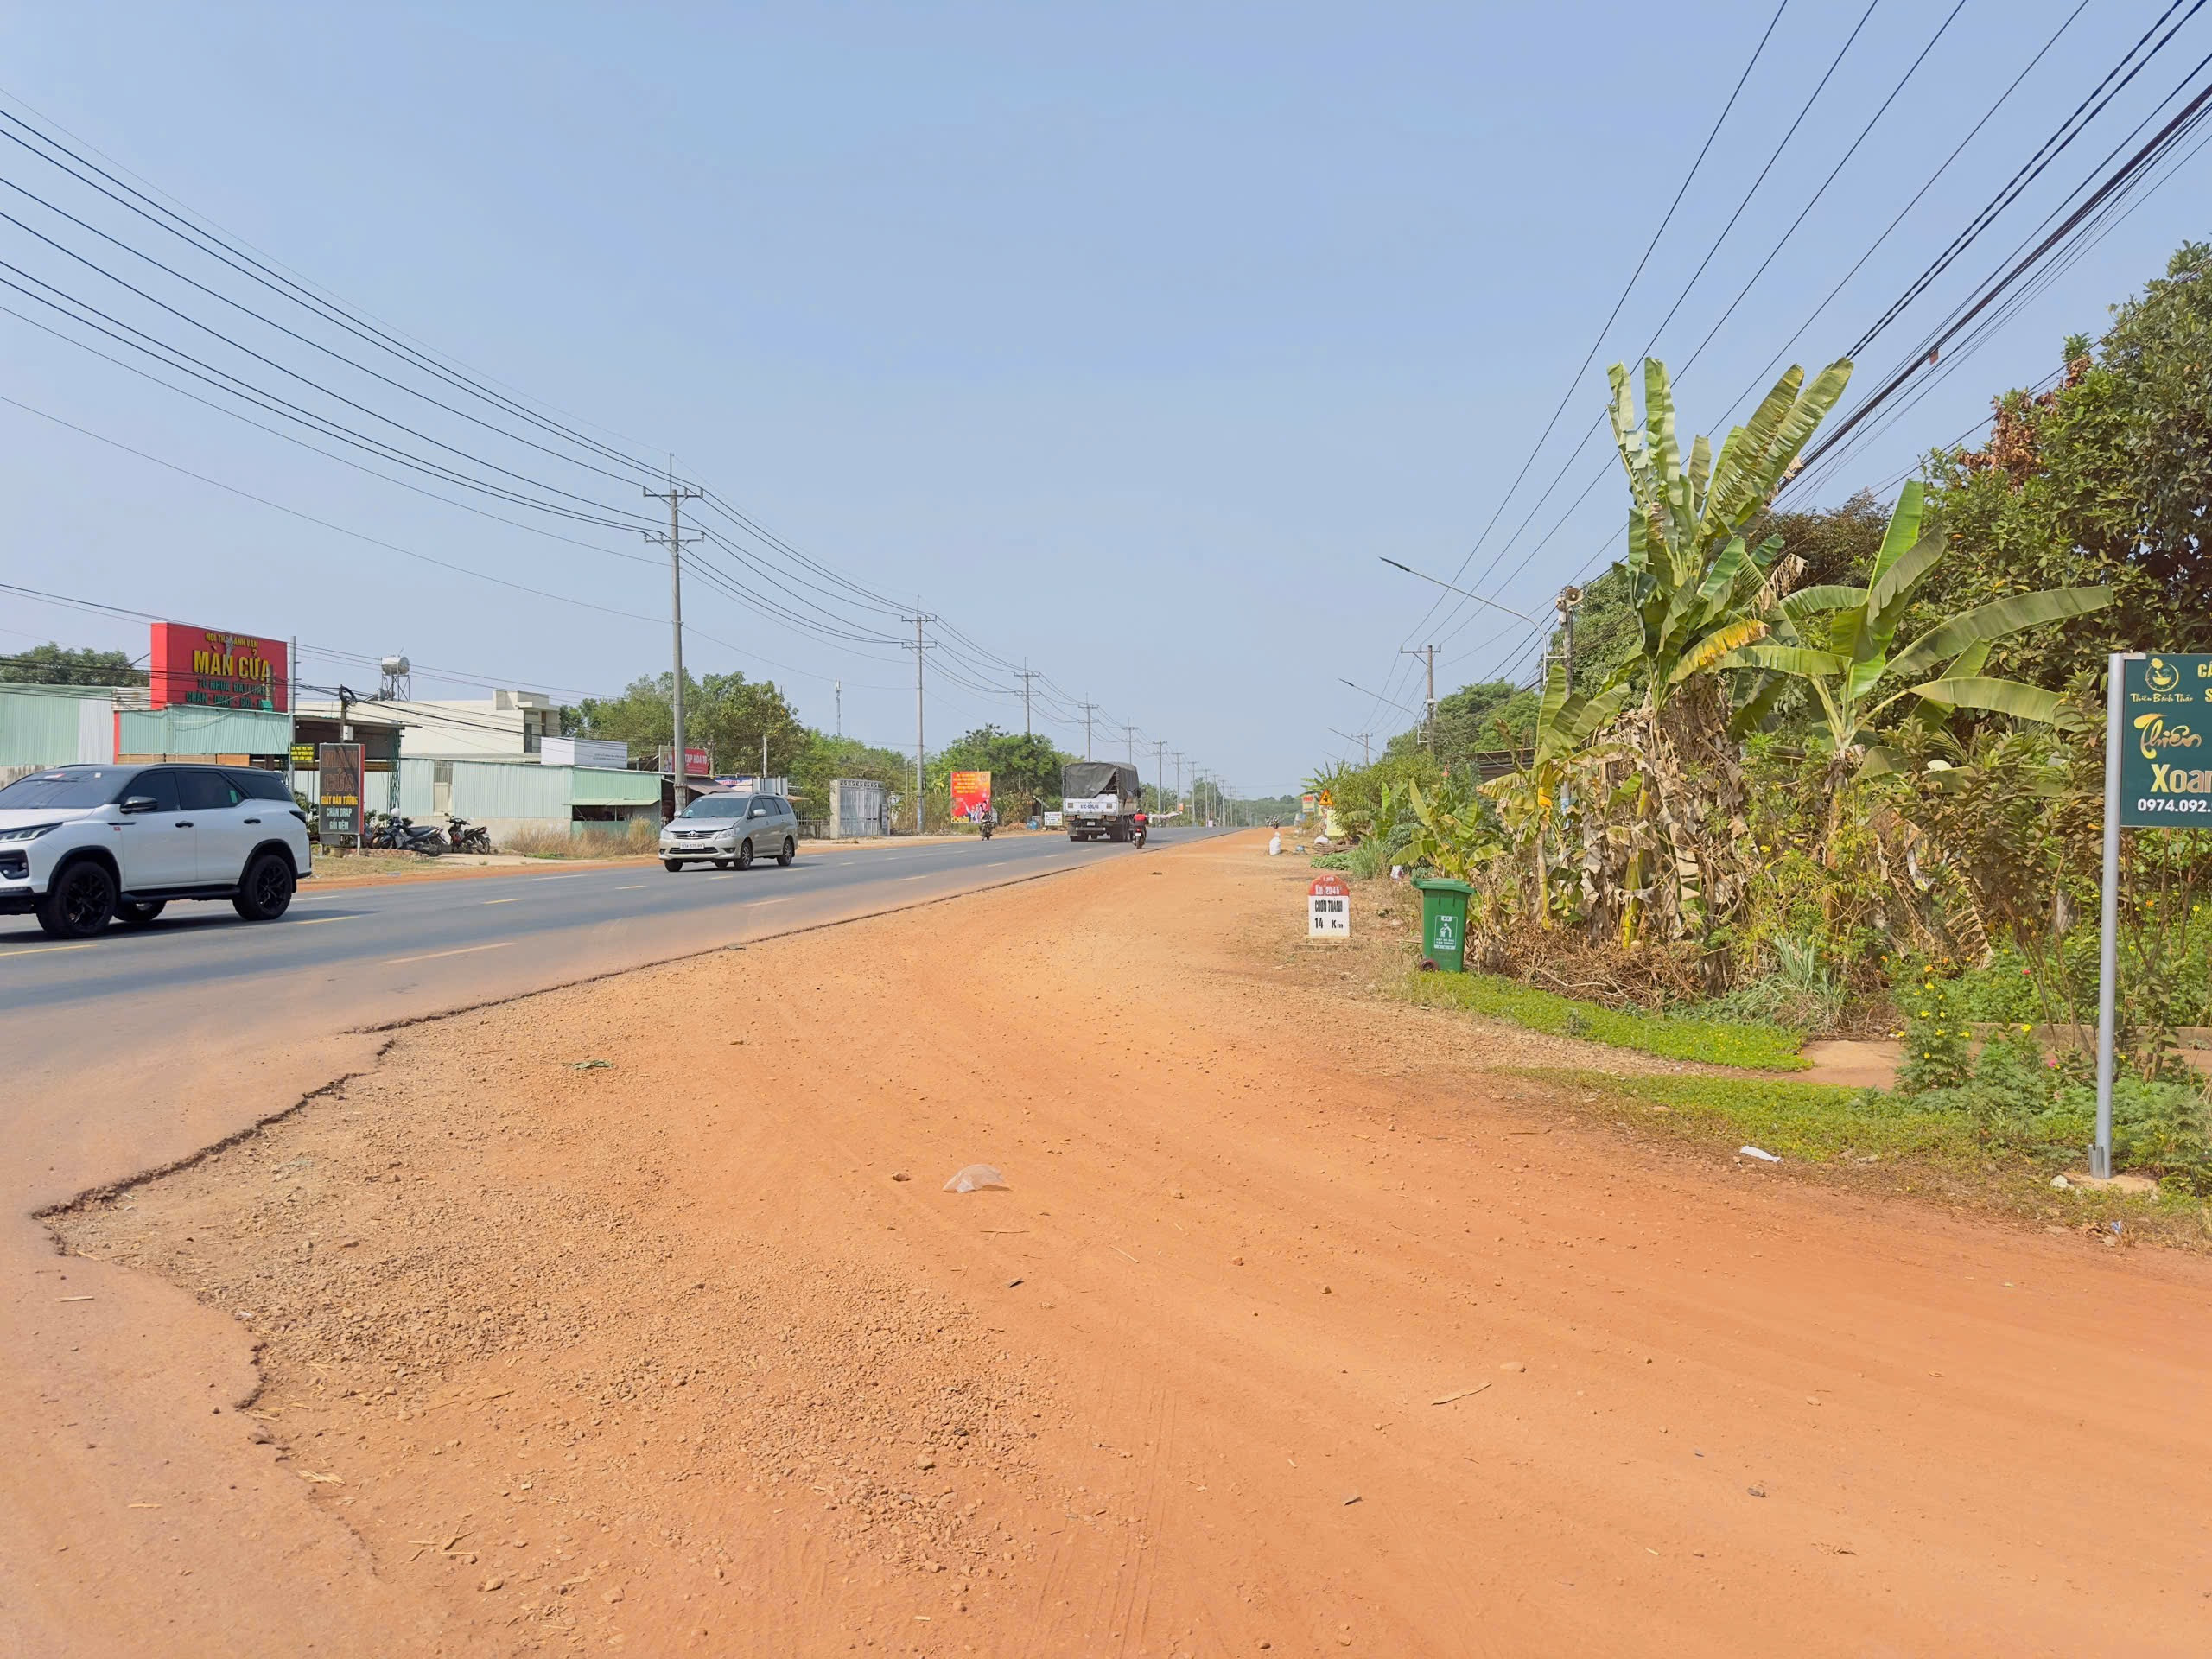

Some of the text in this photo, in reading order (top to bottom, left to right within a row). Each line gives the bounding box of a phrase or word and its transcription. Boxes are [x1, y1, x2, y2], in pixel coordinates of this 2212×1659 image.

[194, 645, 270, 682] MÀN CỬA
[2153, 692, 2174, 702] Bách
[2137, 798, 2212, 813] 0974.092.
[1314, 918, 1344, 929] 14 Km
